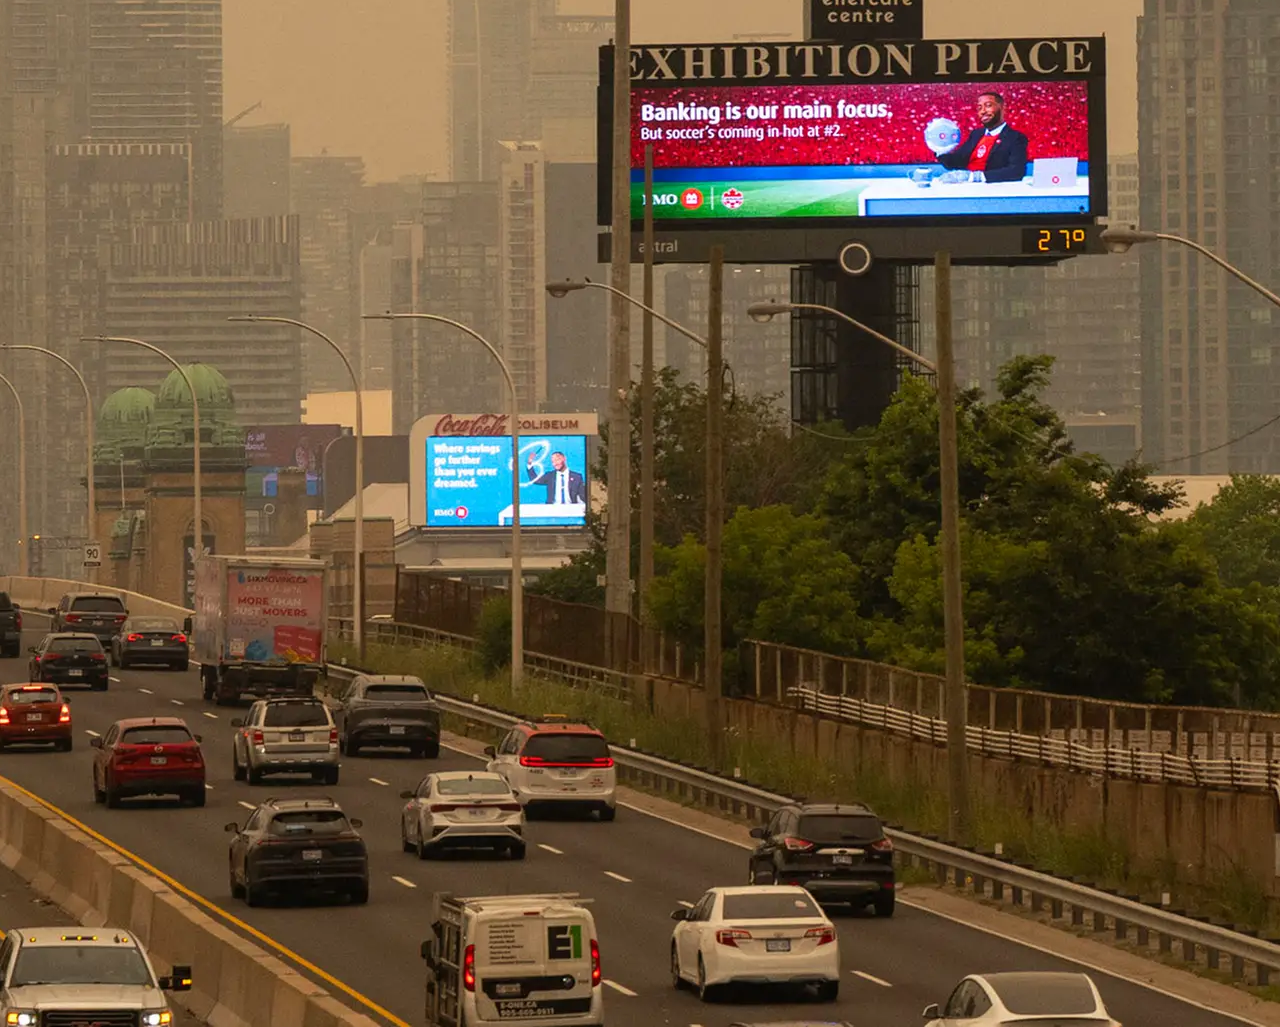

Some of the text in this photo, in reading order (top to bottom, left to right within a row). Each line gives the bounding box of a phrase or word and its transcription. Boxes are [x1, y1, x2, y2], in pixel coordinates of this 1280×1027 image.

[827, 9, 895, 23] centre
[629, 40, 1093, 81] EXHIBITION PLACE
[641, 102, 720, 125] Banking
[725, 101, 742, 119] is
[746, 105, 779, 120] our
[783, 100, 832, 119] main
[640, 124, 844, 141] But soccer’s coming in hot at #2.
[638, 239, 678, 253] atral
[433, 443, 501, 455] Where savings
[434, 455, 481, 466] go further
[434, 467, 498, 478] than you ever
[433, 478, 478, 489] dreamed.
[86, 548, 99, 559] 90
[237, 596, 302, 607] MORE THAN
[234, 606, 308, 617] JUST MOVERS
[547, 925, 582, 960] E1
